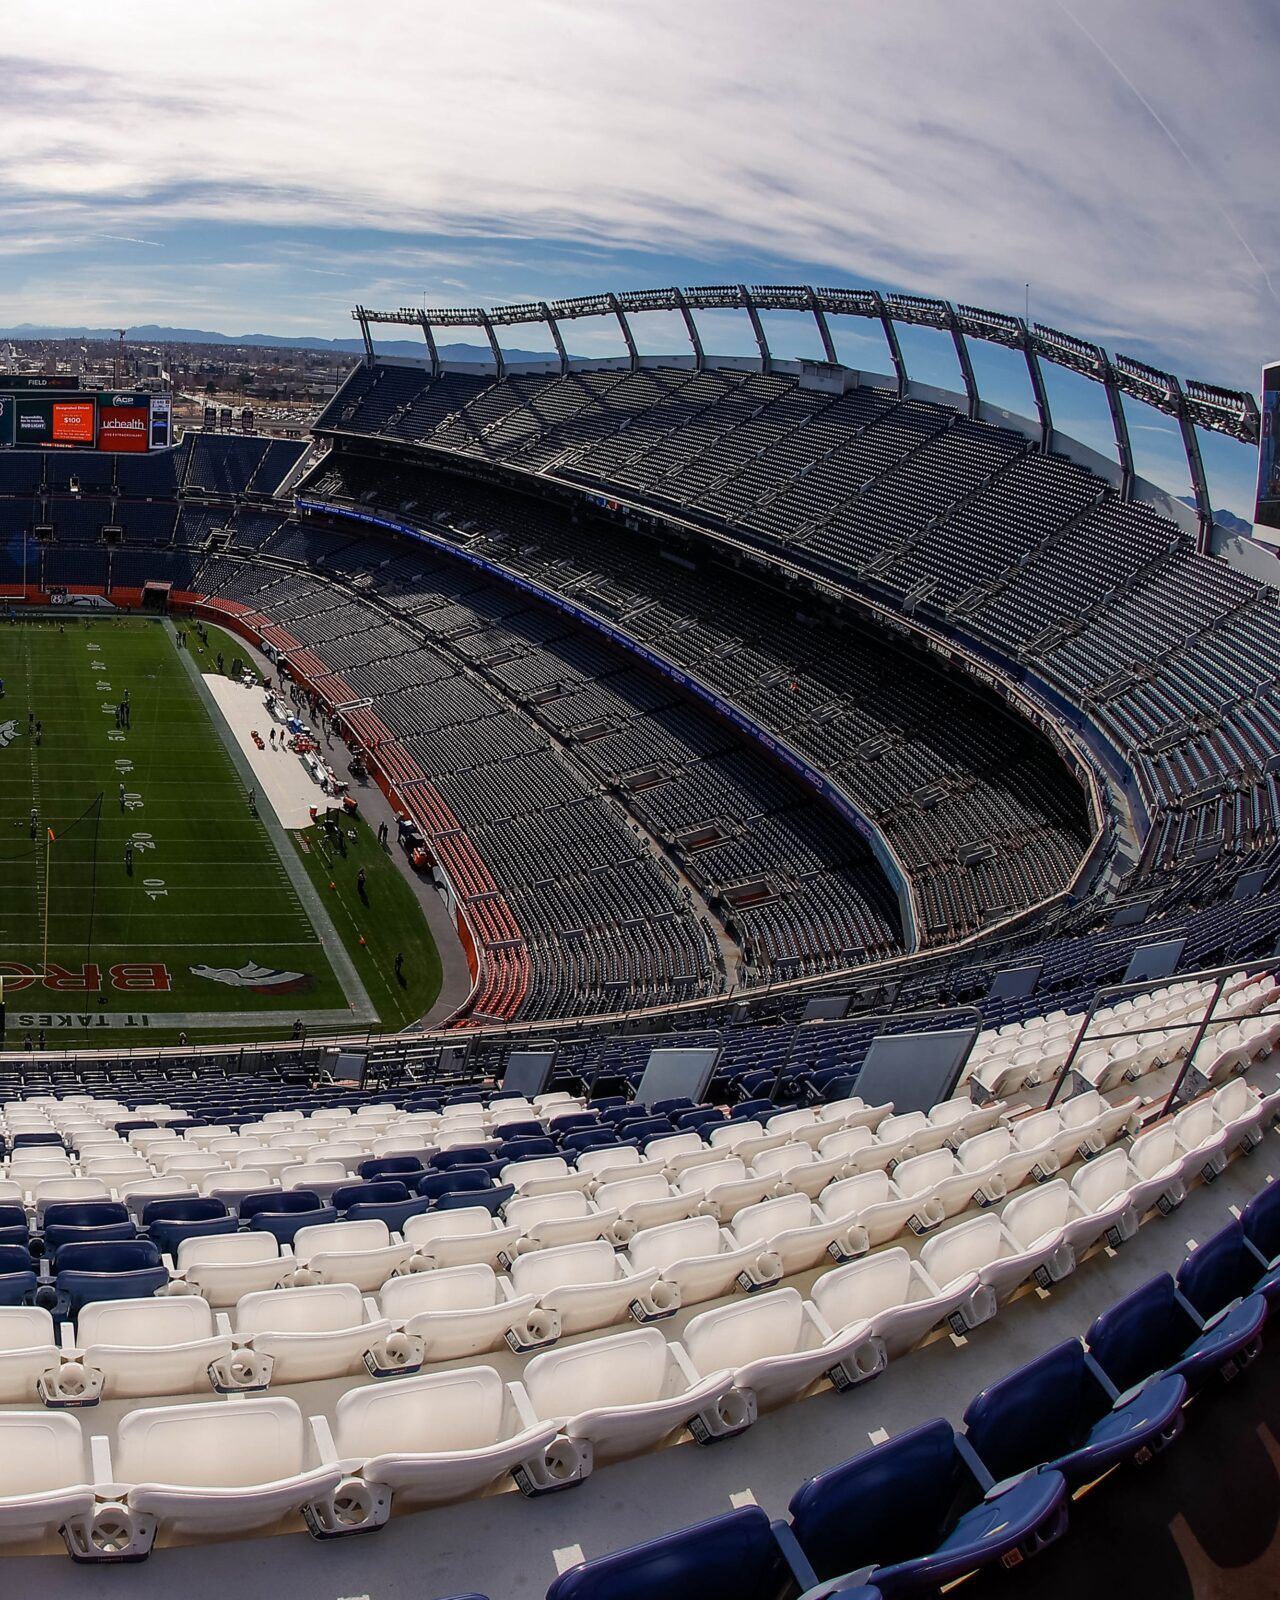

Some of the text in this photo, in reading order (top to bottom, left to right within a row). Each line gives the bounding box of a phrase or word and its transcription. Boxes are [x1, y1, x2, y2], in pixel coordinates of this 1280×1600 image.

[103, 418, 144, 429] uchealth
[599, 624, 613, 635] GEICO
[633, 645, 648, 658] GEICO
[670, 669, 686, 682] GEICO
[714, 700, 731, 717] GEICO
[107, 730, 126, 741] 50
[758, 732, 775, 750] GEICO
[114, 759, 134, 772] 40
[804, 769, 823, 788] GEICO
[123, 793, 144, 808] 30
[131, 832, 156, 849] 20
[142, 878, 168, 896] 10
[18, 1014, 110, 1027] TAKES
[124, 1014, 149, 1027] IT
